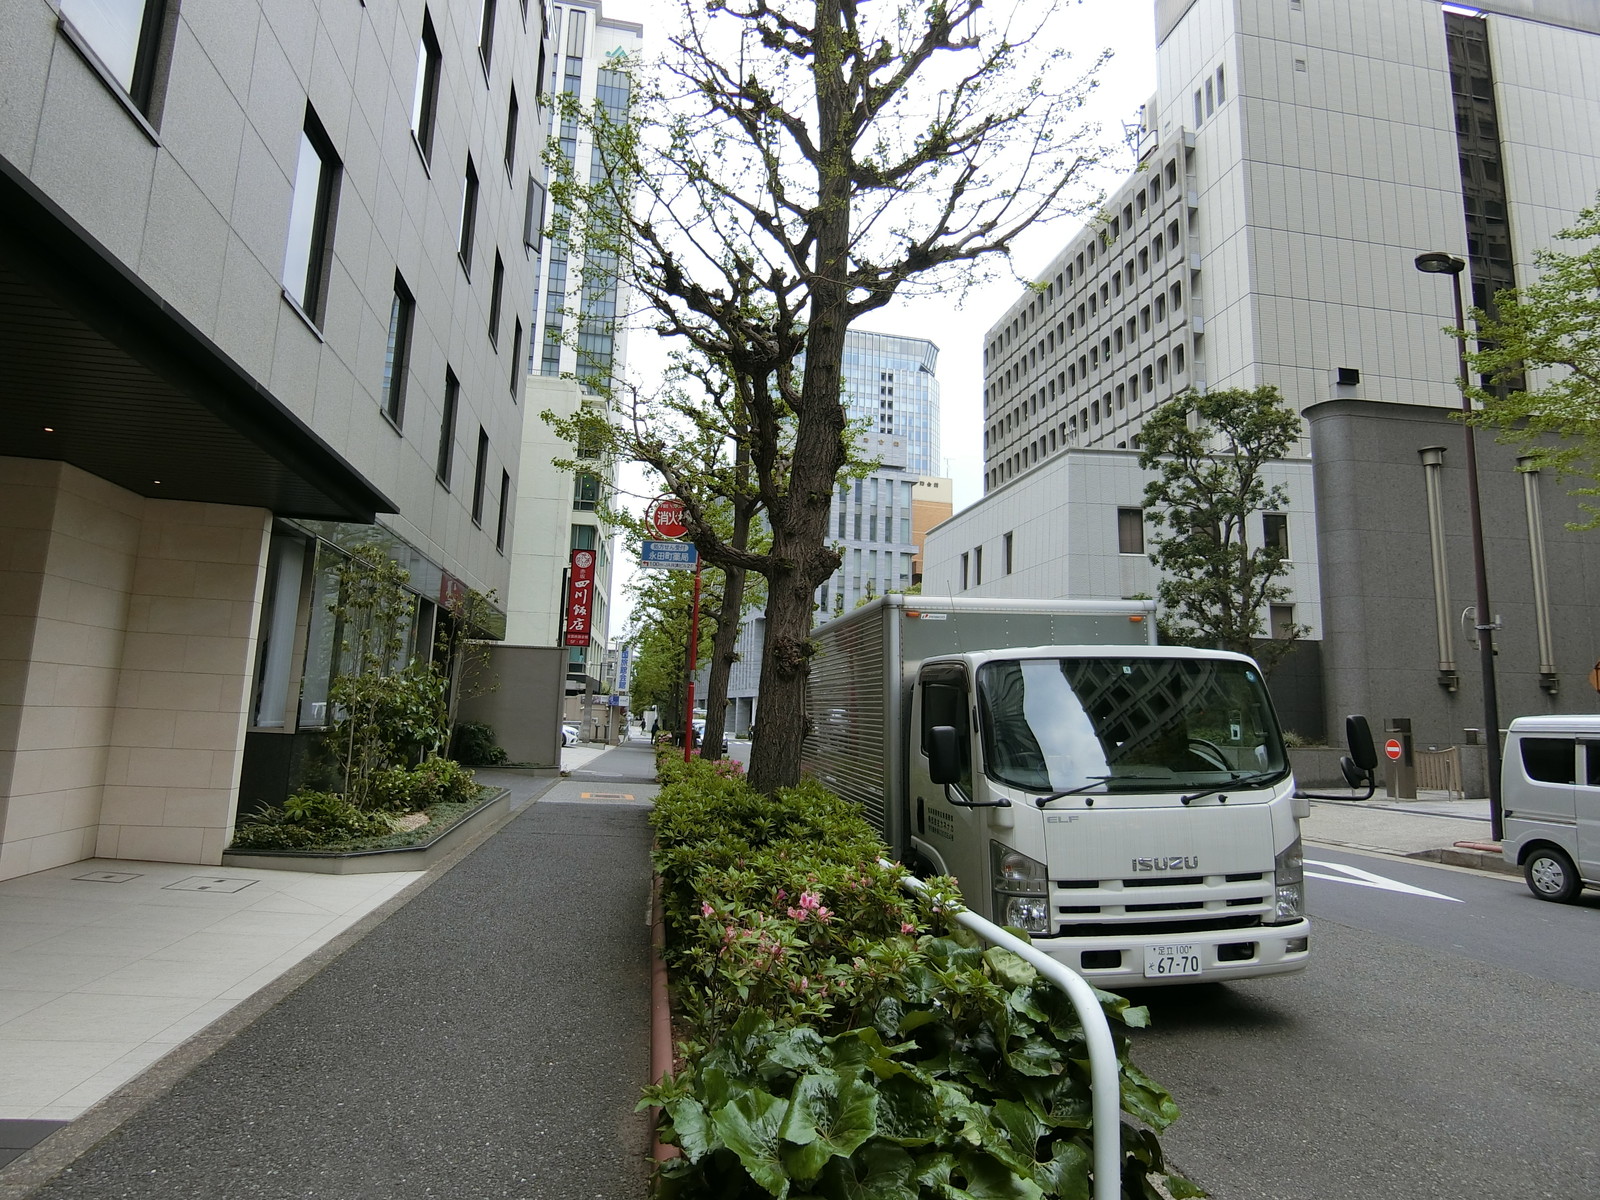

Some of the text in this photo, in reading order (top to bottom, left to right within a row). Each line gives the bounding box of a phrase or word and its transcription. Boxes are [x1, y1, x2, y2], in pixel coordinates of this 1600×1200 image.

[648, 551, 689, 562] 永田町薬局
[569, 580, 590, 631] 四川飯店
[1046, 815, 1080, 824] ELF
[1131, 855, 1199, 872] ISUZU
[1157, 955, 1199, 974] 67-70
